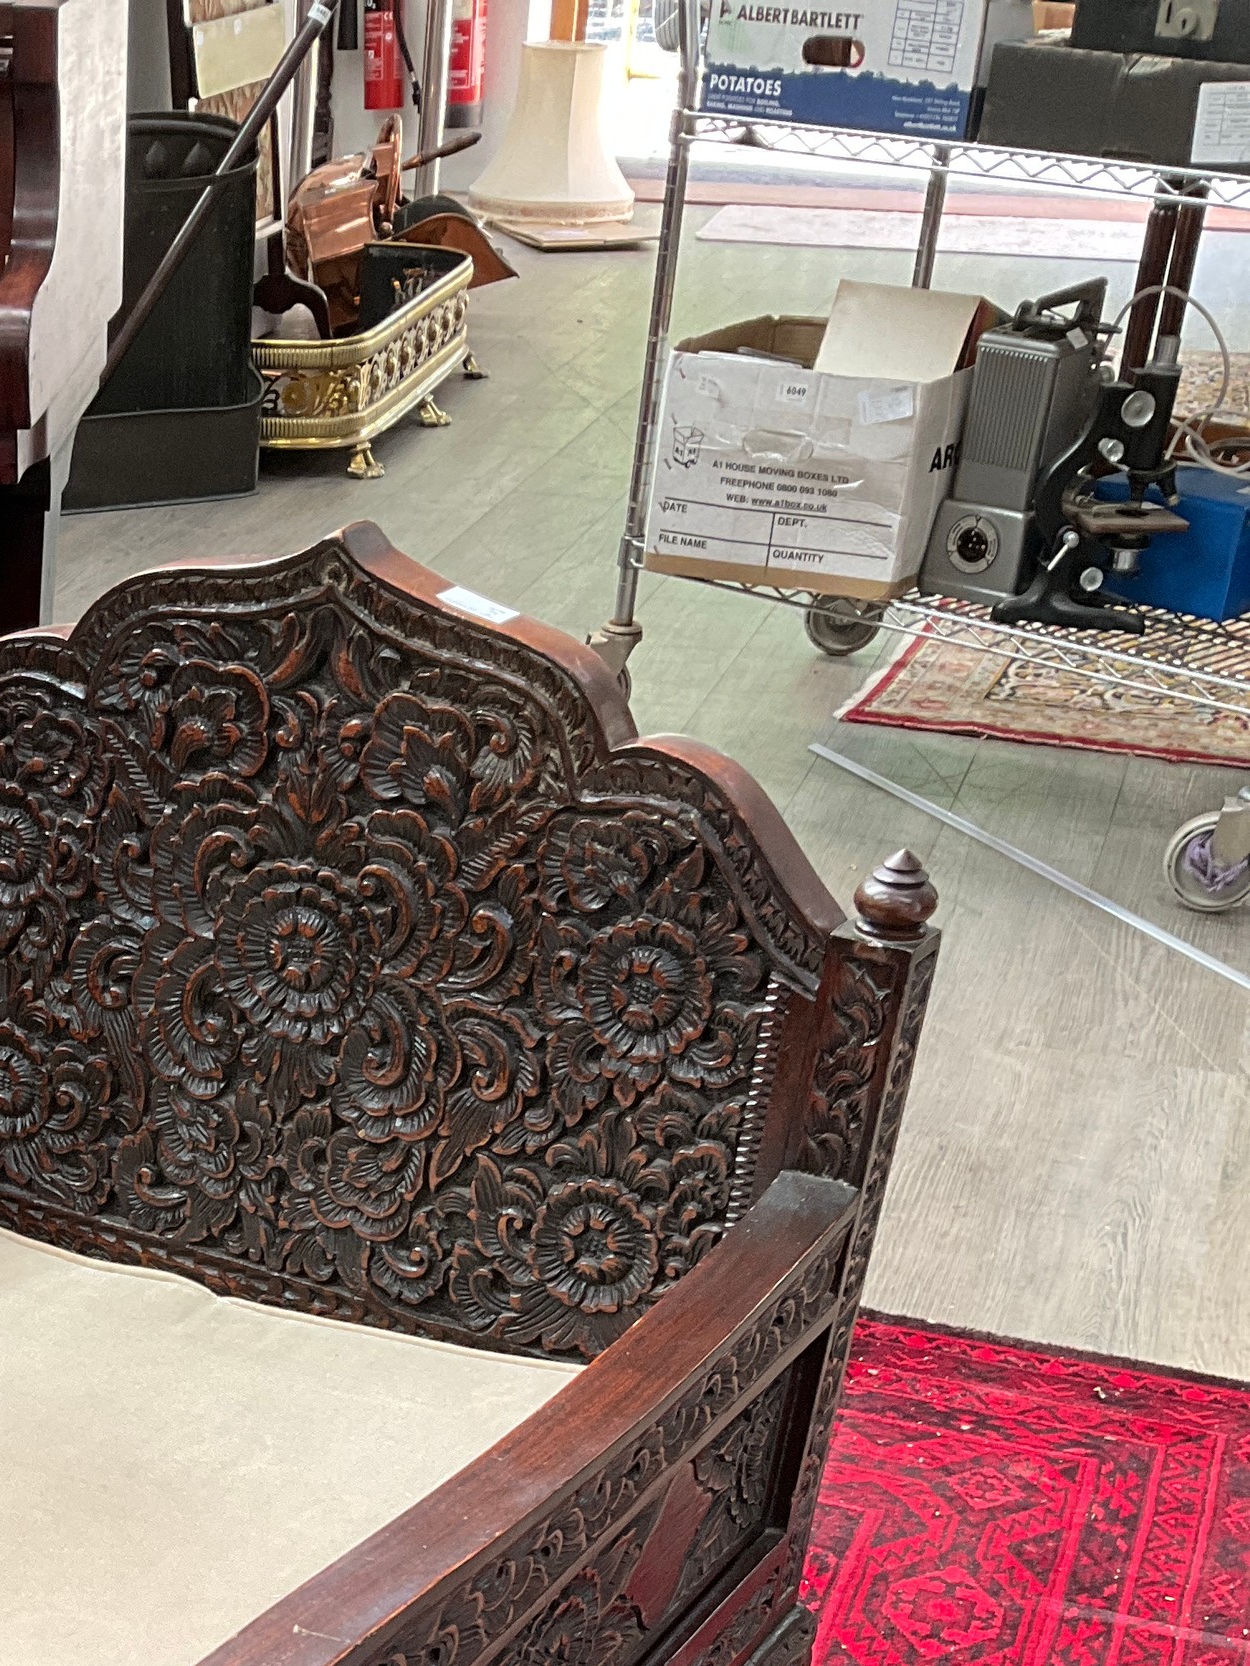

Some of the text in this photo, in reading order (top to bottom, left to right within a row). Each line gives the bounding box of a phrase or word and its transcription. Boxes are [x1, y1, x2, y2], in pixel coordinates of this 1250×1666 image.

[737, 4, 861, 30] ALBERT BARTLETT
[710, 73, 781, 96] POTATOES
[786, 386, 806, 396] 6049
[712, 460, 849, 484] A1 HOUSE MOVING BOXES LTD
[720, 477, 775, 491] FREEPHONE
[776, 483, 798, 494] 0800
[799, 486, 815, 495] 093
[663, 500, 687, 513] DATE
[751, 496, 827, 513] www.a1box.co.uk
[777, 516, 808, 529] DEPT.
[659, 533, 707, 549] FILE NAME
[772, 549, 824, 564] QUANTITY
